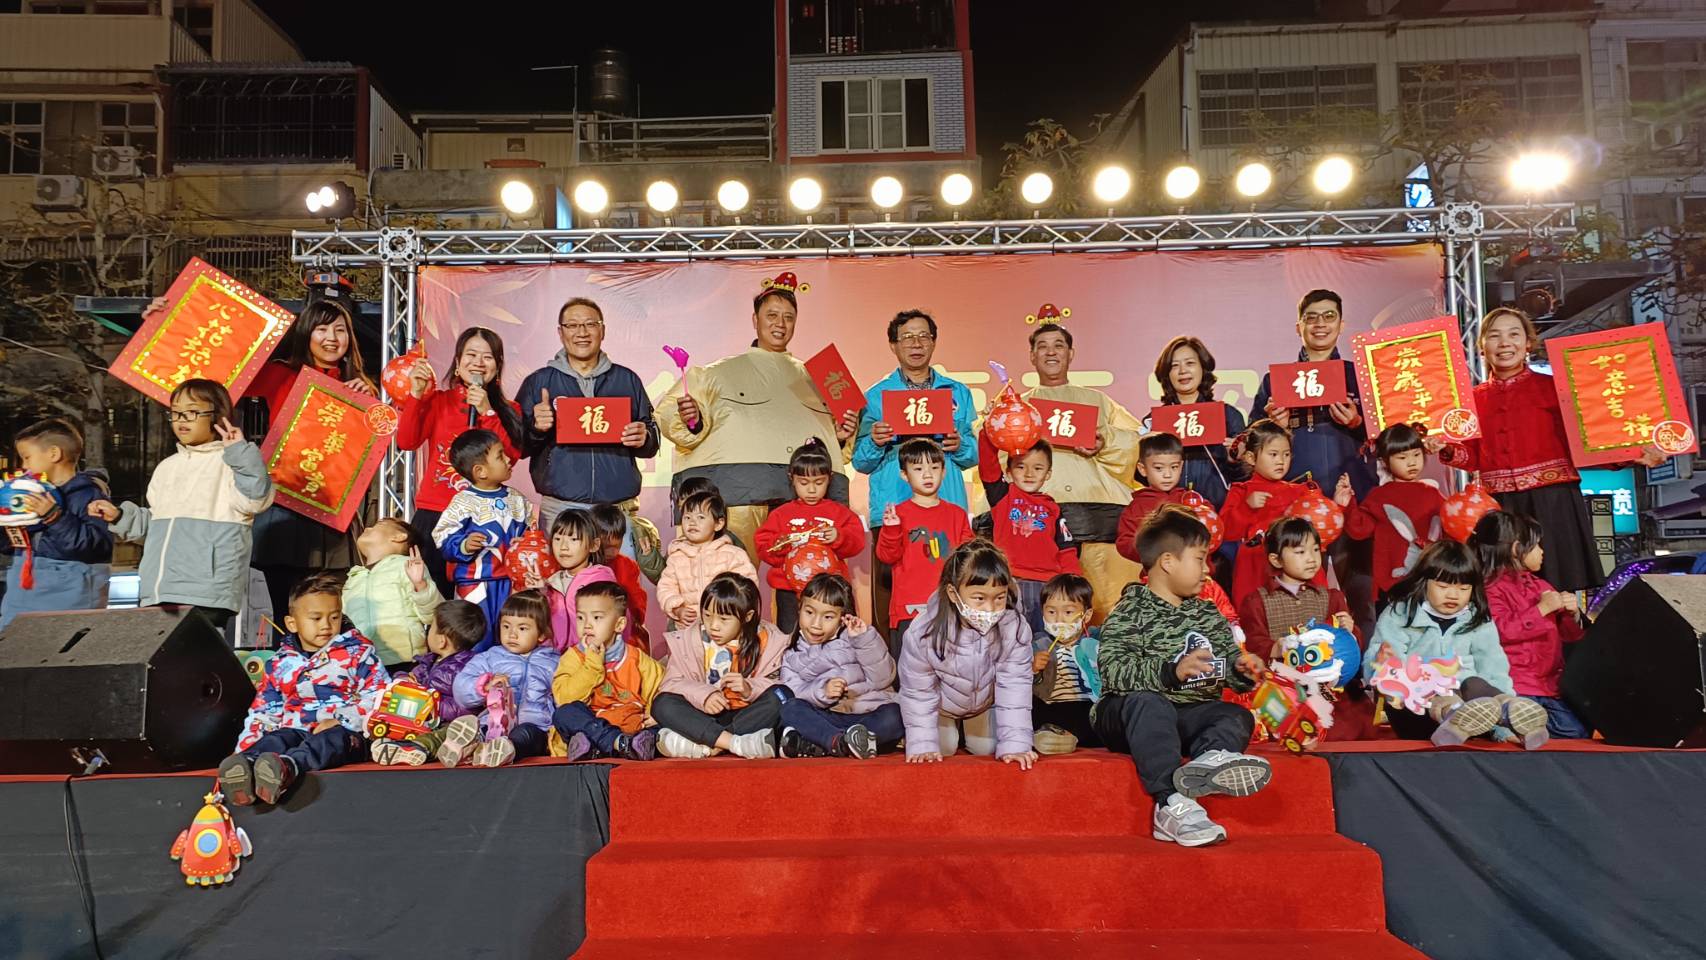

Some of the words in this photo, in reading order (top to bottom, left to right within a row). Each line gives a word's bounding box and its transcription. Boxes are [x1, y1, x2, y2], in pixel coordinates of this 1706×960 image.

[824, 370, 851, 401] 福
[1292, 368, 1325, 400] 福
[1589, 353, 1656, 438] 如意吉祥
[578, 405, 610, 435] 福
[903, 397, 934, 427] 福
[1046, 408, 1077, 438] 福
[1173, 410, 1205, 439] 福
[300, 402, 346, 497] 榮華富貴
